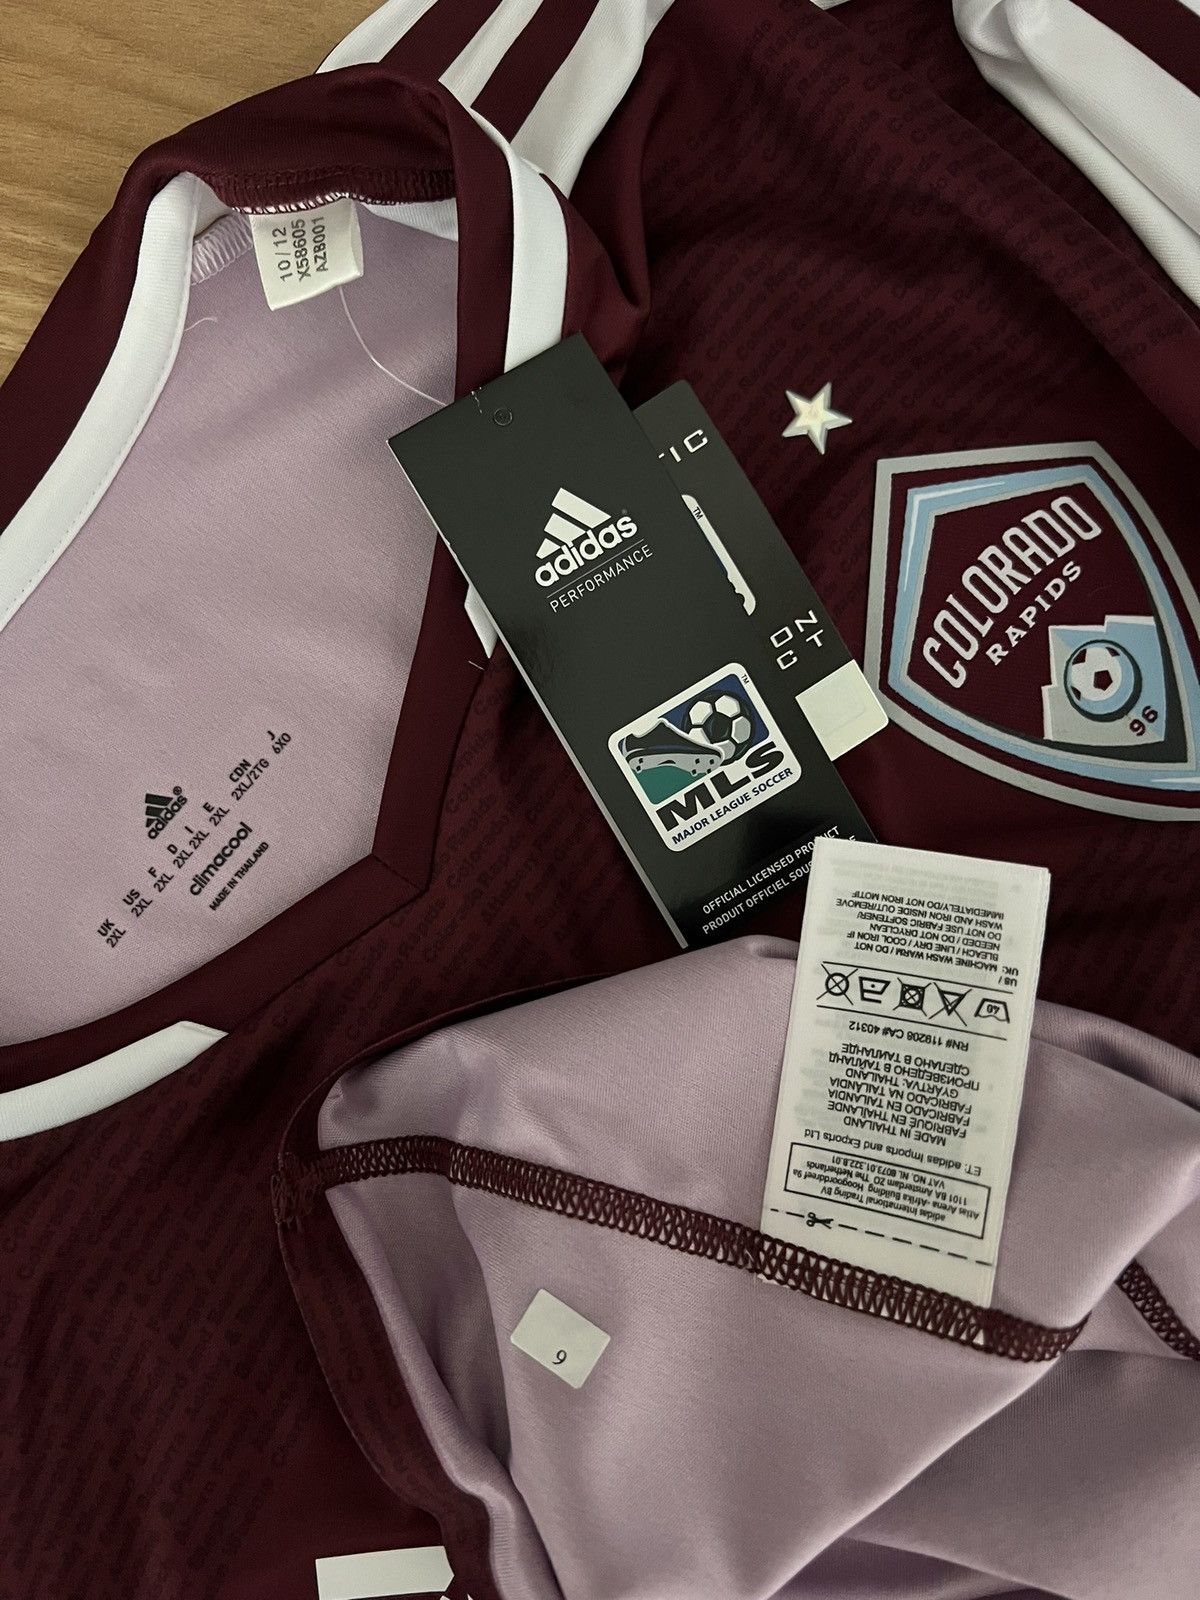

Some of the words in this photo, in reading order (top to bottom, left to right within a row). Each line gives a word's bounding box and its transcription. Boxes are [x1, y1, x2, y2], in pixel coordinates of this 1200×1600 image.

[272, 227, 293, 282] 10/12
[291, 218, 311, 282] X58605
[535, 516, 638, 587] adidas
[549, 545, 653, 613] PERFORMANCE
[922, 495, 1103, 689] COLORADO
[985, 560, 1082, 666] RAPIDS
[1129, 705, 1159, 737] 96
[656, 741, 784, 832] MLS
[671, 817, 710, 845] MAJOR
[709, 792, 751, 821] LEAGUE
[752, 767, 793, 796] SOCCER
[147, 795, 188, 840] adidas
[98, 919, 114, 937] UK
[123, 889, 140, 906] US
[147, 867, 157, 878] F
[167, 844, 178, 855] D
[185, 826, 194, 834] I
[203, 802, 214, 813] E
[229, 759, 251, 783] CDN
[267, 731, 275, 740] J
[106, 929, 126, 948] 2XL
[131, 898, 152, 917] 2XL
[154, 873, 174, 893] 2XL
[173, 850, 194, 869] 2XL
[189, 832, 209, 850] 2XL
[209, 807, 230, 827] 2XL
[231, 758, 269, 801] 2XL/2TG
[190, 822, 253, 896] climacool
[209, 887, 231, 911] MADE
[227, 878, 238, 889] IN
[234, 842, 269, 879] THAILAND
[702, 884, 747, 915] OFFICIAL
[747, 854, 795, 888] LICENSED
[851, 891, 880, 901] MOTIF
[881, 894, 904, 905] IRON
[702, 902, 745, 935] PRODUIT
[747, 877, 790, 908] OFFICIEL
[905, 898, 925, 908] NOT
[897, 906, 927, 918] INSIDE
[926, 901, 1004, 920] IMMEDIATELY/DO
[929, 911, 952, 922] IRON
[910, 919, 943, 931] FABRIC
[953, 915, 974, 925] AND
[975, 919, 1003, 930] WASH
[869, 923, 918, 938] DRYCLEAN
[919, 931, 939, 941] NOT
[945, 924, 964, 935] USE
[965, 928, 986, 938] NOT
[987, 931, 1002, 941] DO
[857, 931, 880, 942] IRON
[881, 935, 907, 946] COOL
[941, 934, 955, 944] DO
[854, 942, 874, 952] NOT
[875, 944, 889, 954] DO
[913, 940, 933, 950] DRY
[934, 943, 955, 954] LINE
[962, 937, 1000, 951] NEEDED
[895, 948, 924, 960] WARM
[926, 953, 953, 964] WASH
[962, 948, 999, 962] BLEACH
[955, 957, 998, 972] MACHINE
[1004, 977, 1017, 987] US
[986, 1004, 1000, 1015] 40
[849, 1021, 880, 1035] 40312
[882, 1027, 904, 1039] CA#
[907, 1031, 943, 1046] 119208
[945, 1039, 969, 1052] RN#
[914, 1057, 970, 1077] СДЕЛАНО
[845, 1068, 899, 1087] THAILAND
[894, 1065, 980, 1091] ПРОИЗВЕДЕНО
[828, 1088, 884, 1109] TAILANDIA
[889, 1088, 904, 1100] NA
[886, 1100, 902, 1112] EN
[906, 1092, 972, 1115] FABRICADO
[891, 1113, 907, 1125] EN
[904, 1104, 970, 1127] FABRICADO
[843, 1116, 897, 1136] THAILAND
[909, 1117, 967, 1139] FABRIQUÉ
[804, 1129, 820, 1140] Ltd
[900, 1127, 912, 1139] IN
[914, 1130, 946, 1147] MADE
[823, 1132, 861, 1149] Exports
[863, 1141, 883, 1151] and
[885, 1145, 924, 1163] Imports
[927, 1155, 962, 1170] adidas
[793, 1169, 802, 1178] 9a
[806, 1161, 853, 1180] Netherlands
[855, 1171, 869, 1183] The
[873, 1176, 885, 1187] ZO
[887, 1179, 933, 1197] Amsterdam
[927, 1178, 945, 1189] VAT
[820, 1186, 833, 1196] BV
[834, 1187, 864, 1203] Trading
[867, 1184, 901, 1201] Building
[935, 1190, 947, 1201] BA
[865, 1196, 918, 1216] International
[949, 1194, 967, 1206] 1101
[932, 1201, 957, 1214] Arena
[959, 1207, 980, 1220] Atlas
[919, 1209, 946, 1222] adidas
